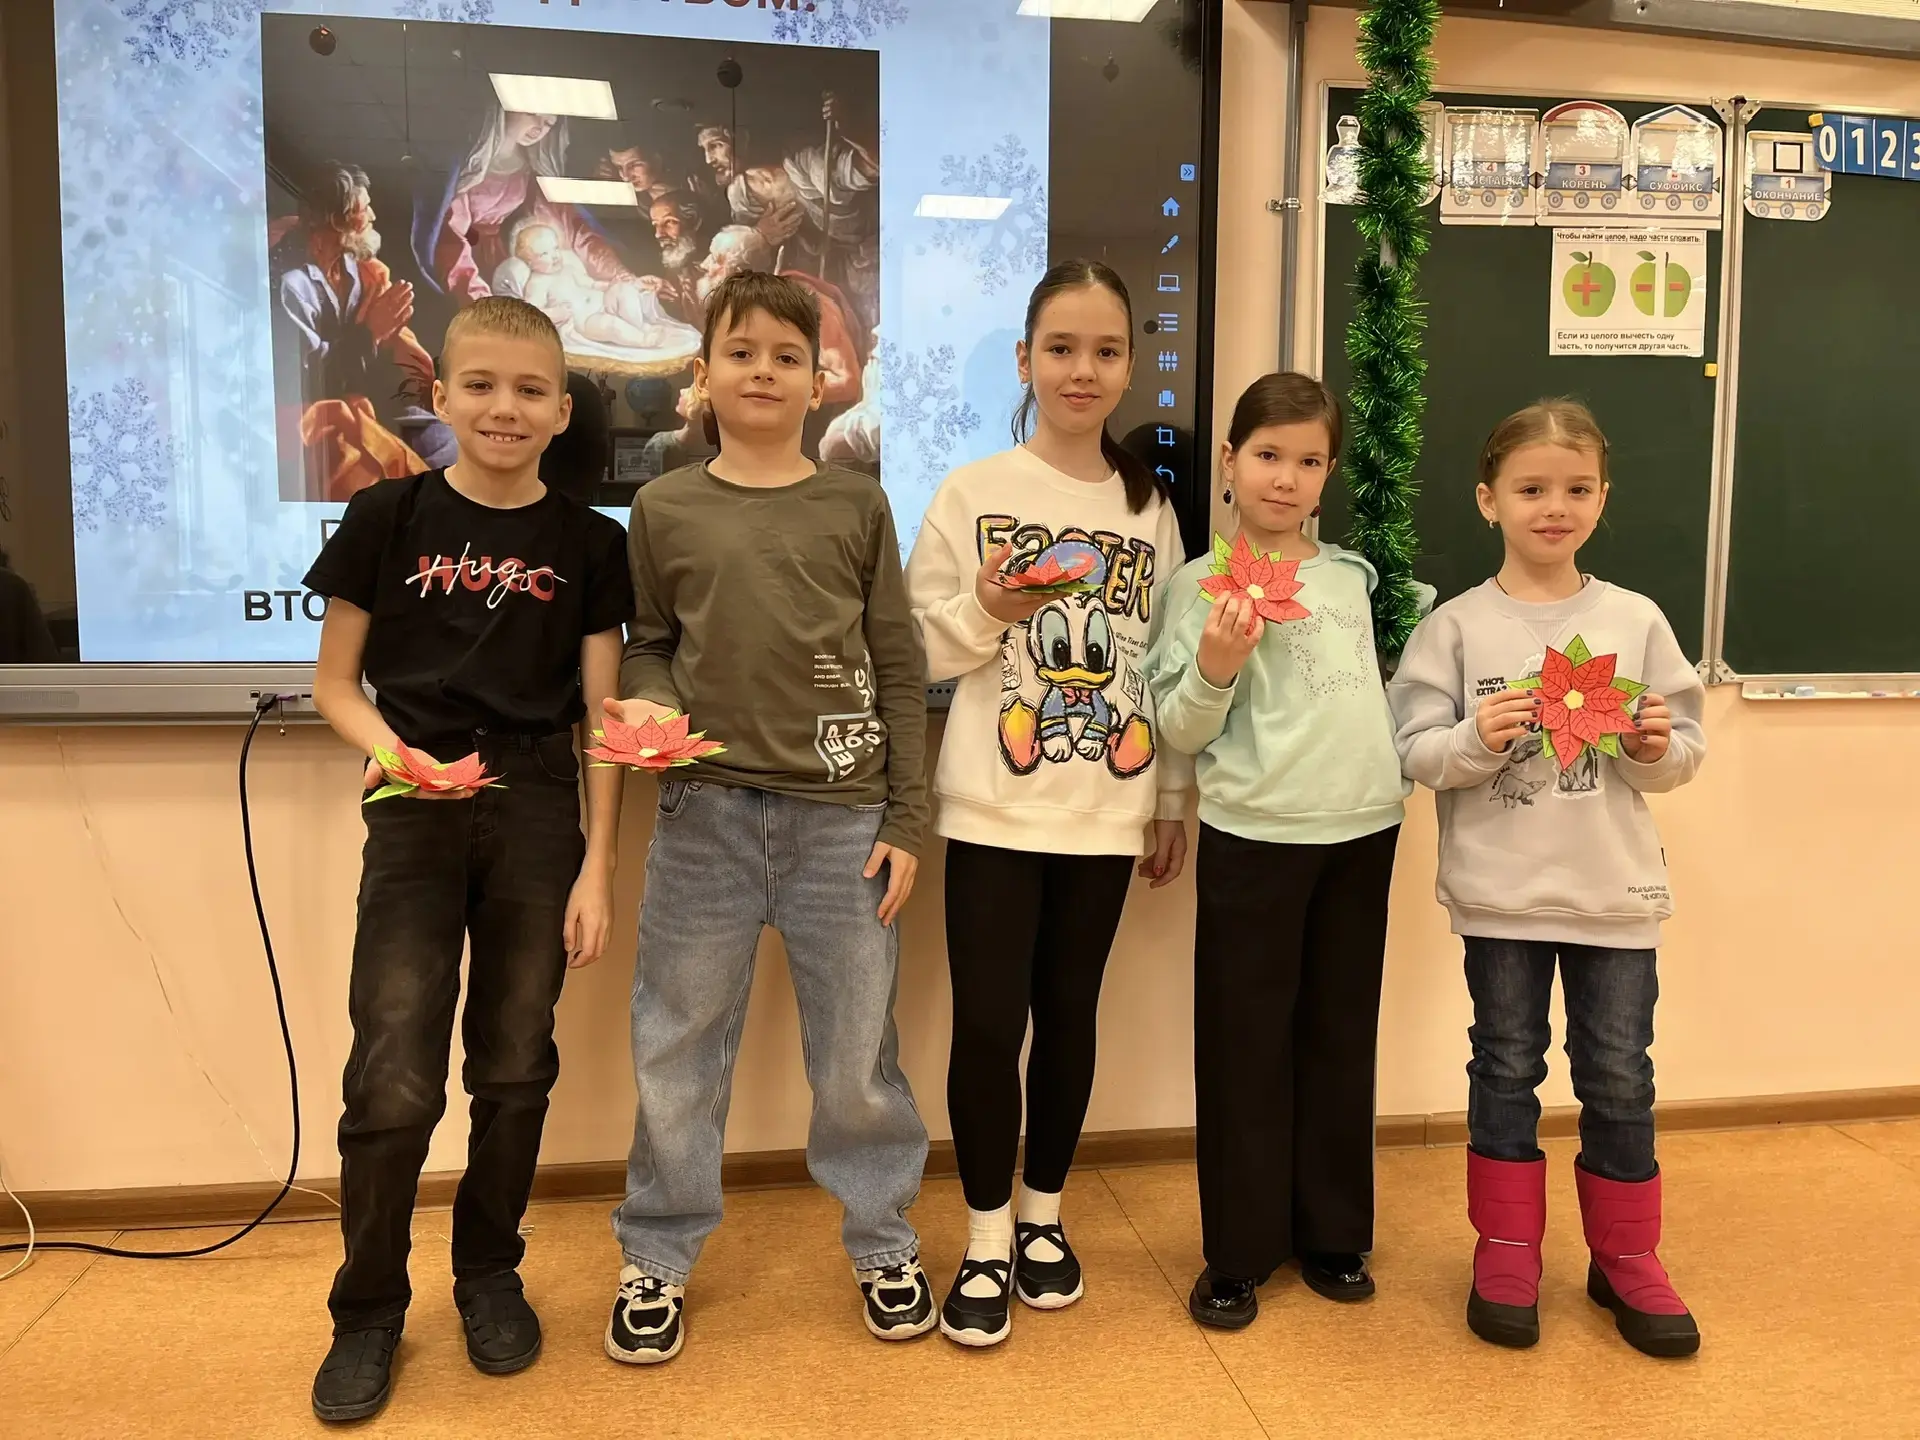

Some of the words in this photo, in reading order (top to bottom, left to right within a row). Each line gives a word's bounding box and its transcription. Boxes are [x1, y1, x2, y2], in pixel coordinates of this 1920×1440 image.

[1819, 125, 1836, 162] 0
[1851, 128, 1864, 165] 1
[1880, 130, 1897, 168] 2
[1579, 166, 1586, 175] 3
[1455, 175, 1525, 187] ИСТАВКА
[1562, 179, 1607, 189] КОРЕНЬ
[1785, 179, 1792, 188] 1
[1649, 181, 1703, 192] СУФФИКС
[1754, 190, 1821, 201] ОКОНЧАНИЕ
[1556, 232, 1580, 240] Чтобы
[1582, 232, 1603, 240] найти
[1604, 234, 1628, 242] целое,
[1629, 234, 1648, 242] надо
[1557, 332, 1578, 340] Если
[1590, 333, 1619, 341] целого
[1656, 333, 1675, 341] одну
[1557, 343, 1582, 351] часть,
[1594, 343, 1637, 351] получится
[1638, 343, 1665, 351] другая
